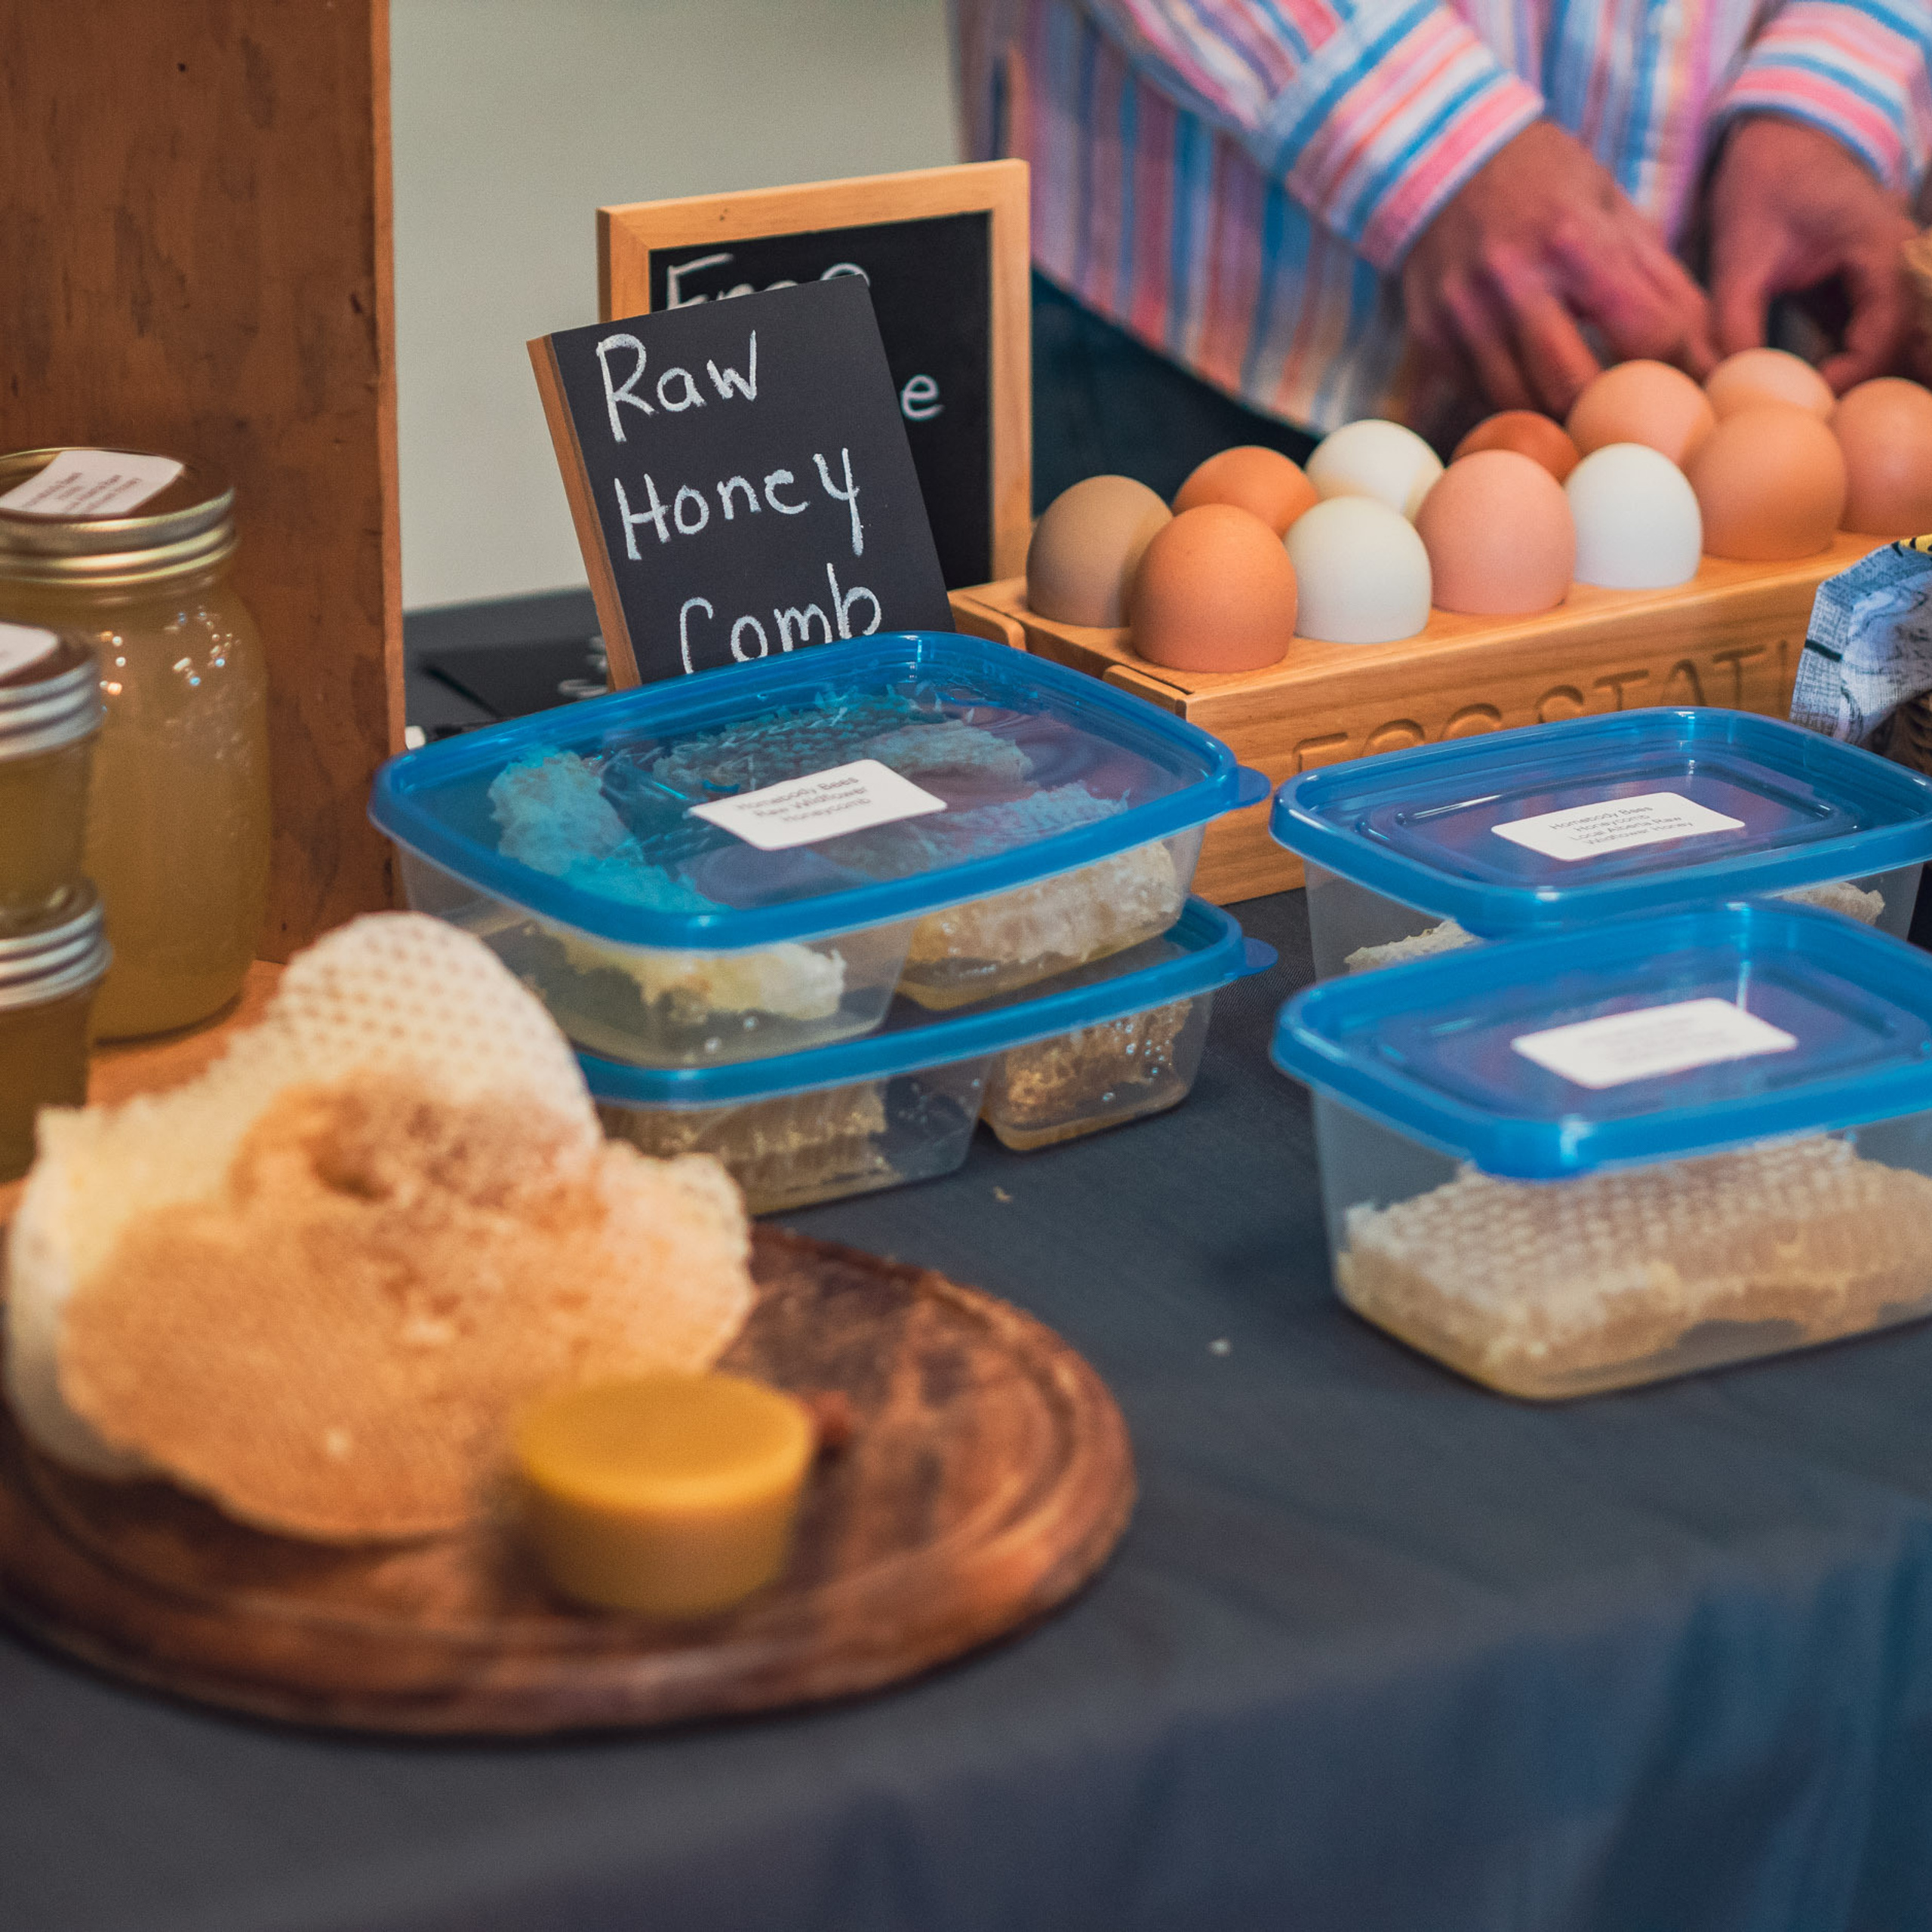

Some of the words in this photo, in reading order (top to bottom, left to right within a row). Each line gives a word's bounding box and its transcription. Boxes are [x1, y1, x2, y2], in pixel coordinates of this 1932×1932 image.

[595, 329, 758, 442] Raw
[614, 448, 863, 560] Honey
[680, 562, 882, 674] Comb
[817, 777, 859, 790] Bees
[1549, 812, 1618, 829] Homebody
[1618, 807, 1654, 815] Bees
[1573, 814, 1650, 832] Honeycomb
